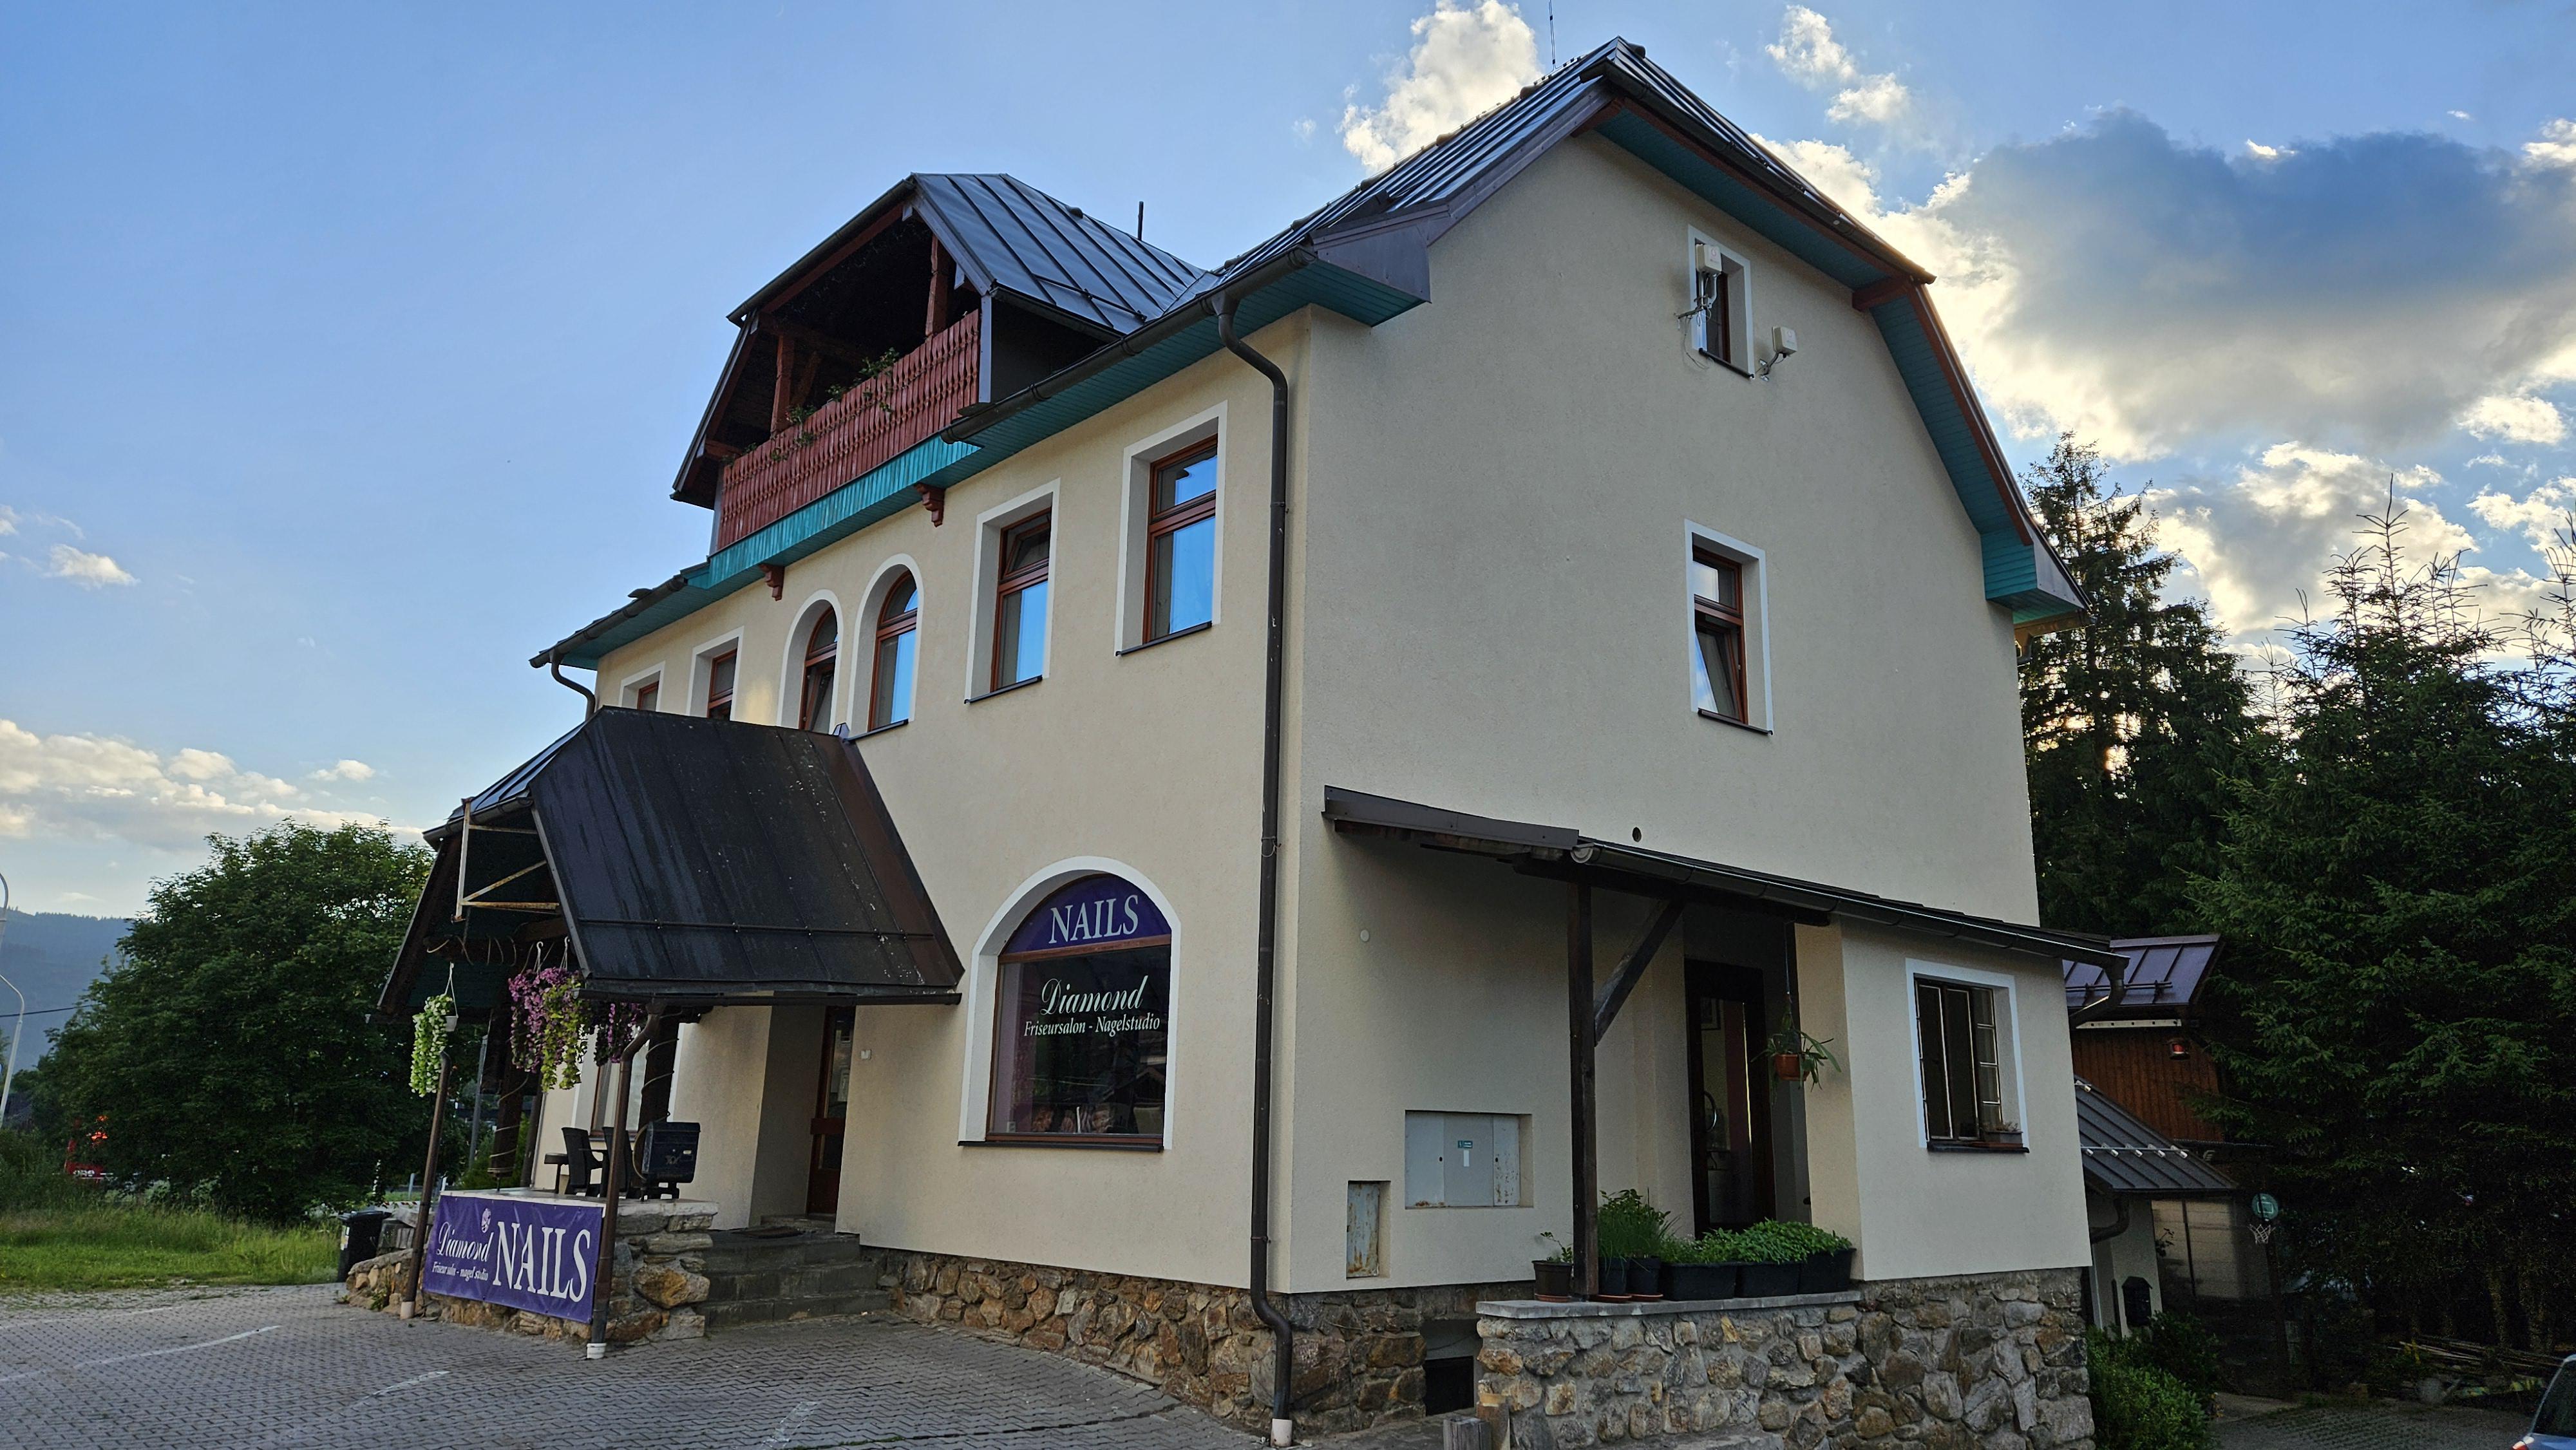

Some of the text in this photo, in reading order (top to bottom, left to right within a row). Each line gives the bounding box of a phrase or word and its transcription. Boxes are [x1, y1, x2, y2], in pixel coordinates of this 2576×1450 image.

[1048, 894, 1139, 944] NAILS
[1040, 975, 1148, 1015] Diamond
[1024, 1017, 1085, 1037] Friseursalon
[1095, 1013, 1160, 1037] Nagelstudio
[436, 1221, 495, 1263] Diamond
[493, 1221, 591, 1303] NAILS
